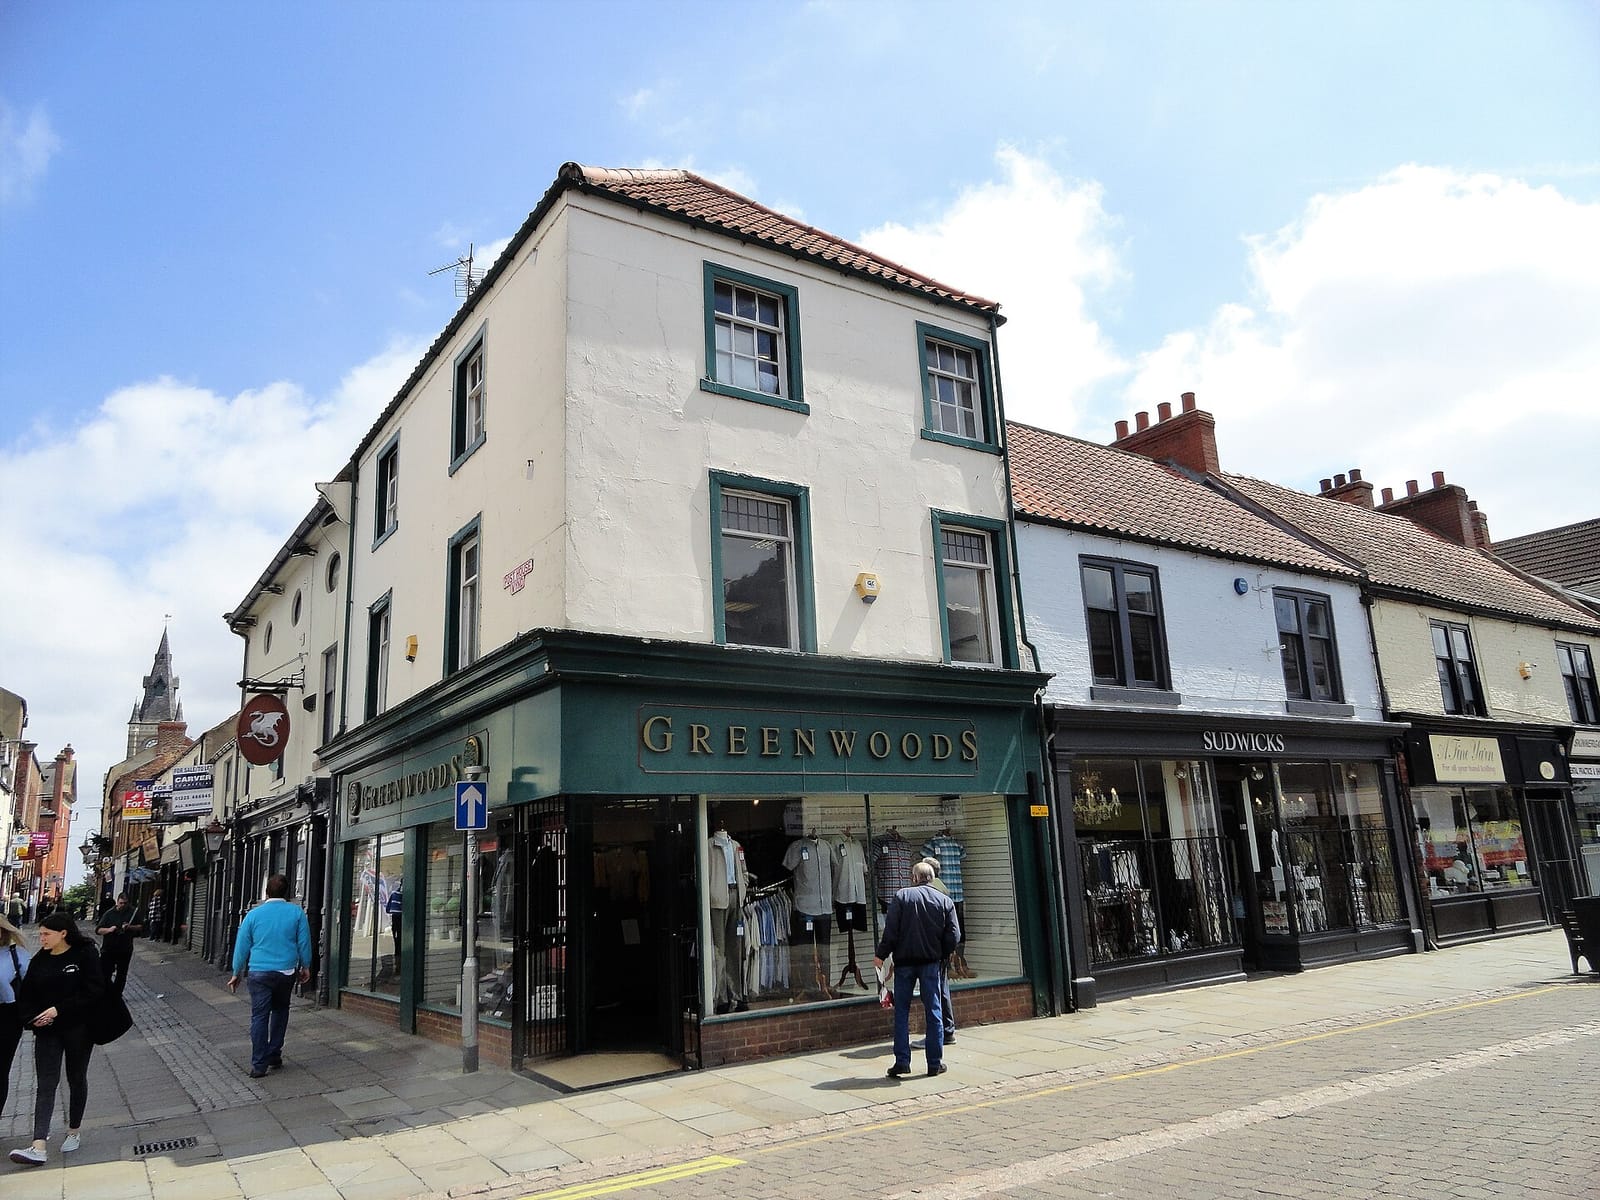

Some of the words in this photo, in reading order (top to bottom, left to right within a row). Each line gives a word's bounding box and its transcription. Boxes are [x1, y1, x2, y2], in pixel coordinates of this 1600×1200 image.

[643, 715, 978, 761] GREENWOODS
[1203, 730, 1285, 752] SUDWICKS
[175, 774, 212, 783] CARVER
[362, 755, 460, 811] GREENWOODS
[126, 799, 143, 808] For
